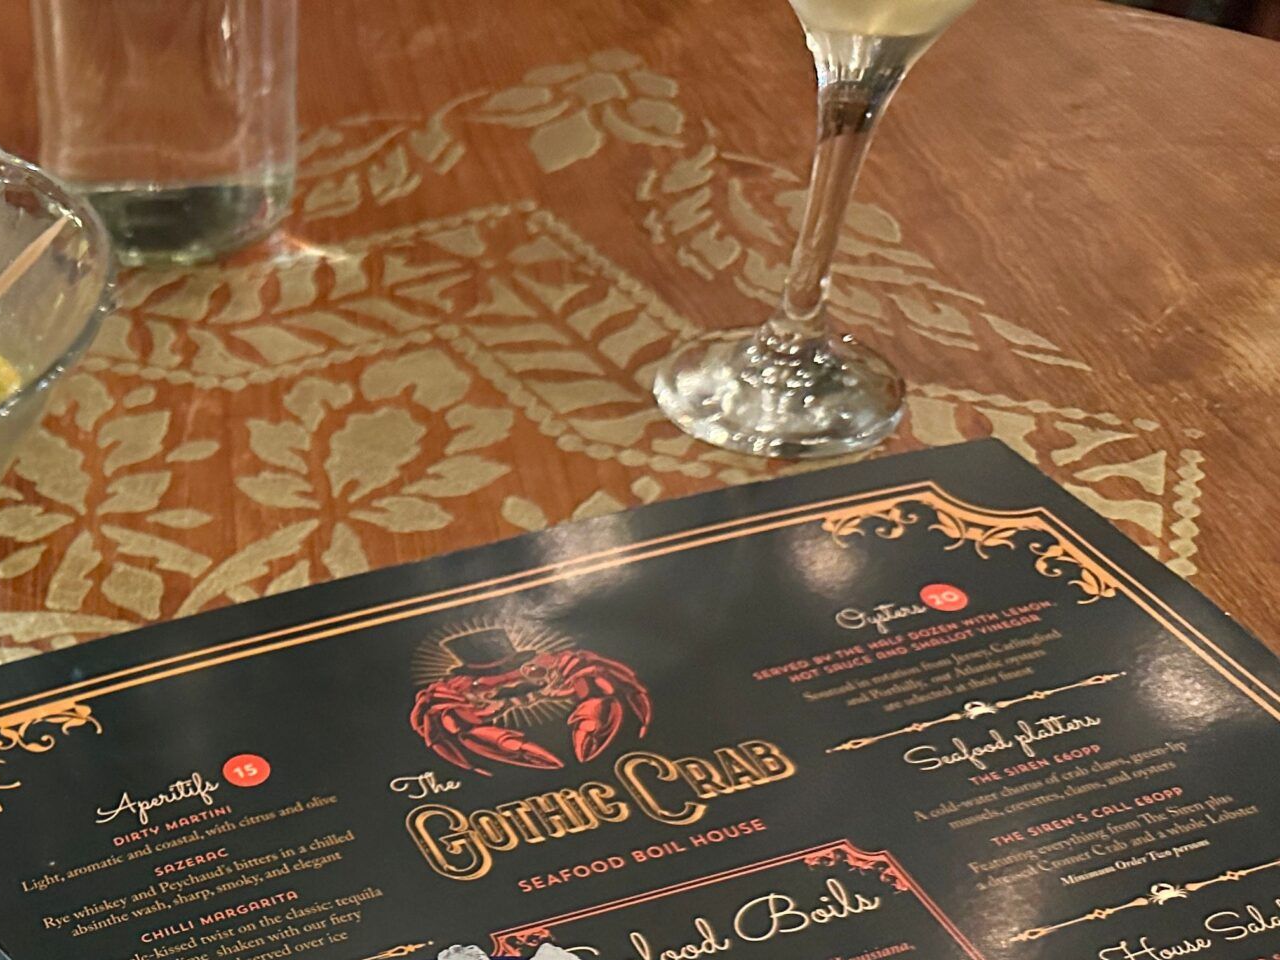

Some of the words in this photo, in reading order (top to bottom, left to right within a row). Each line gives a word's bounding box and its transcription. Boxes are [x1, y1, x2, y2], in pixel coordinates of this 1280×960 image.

[836, 601, 927, 634] Oysters
[752, 659, 813, 680] SERVED
[811, 653, 837, 668] BY
[834, 644, 868, 663] THE
[867, 635, 905, 655] HALF
[907, 622, 963, 646] DOZEN
[961, 612, 1004, 633] WITH
[788, 667, 819, 683] HOT
[822, 654, 872, 673] SAUCE
[875, 645, 908, 659] AND
[910, 628, 973, 651] SHALLOT
[978, 613, 1041, 633] VINEGAR
[904, 733, 1013, 771] Seafood
[1014, 713, 1101, 757] platters
[390, 772, 461, 799] The
[614, 741, 796, 826] CRAB
[969, 770, 1002, 785] THE
[1003, 758, 1050, 776] SIREN
[1106, 770, 1132, 785] and
[95, 772, 219, 825] Aperitifs
[991, 830, 1024, 846] THE
[1090, 801, 1132, 818] CALL
[21, 874, 65, 892] Light,
[66, 855, 123, 878] aromatic
[126, 843, 152, 860] and
[154, 829, 204, 851] coastal,
[204, 820, 236, 836] with
[238, 811, 276, 827] citrus
[278, 800, 304, 816] and
[305, 795, 337, 809] olive
[112, 825, 159, 846] DIRTY
[164, 805, 231, 830] MARTINI
[1037, 829, 1109, 854] everything
[1106, 819, 1146, 841] from
[1140, 811, 1168, 824] The
[1165, 802, 1210, 825] Siren
[1130, 829, 1156, 846] and
[42, 914, 70, 929] Rye
[73, 897, 126, 918] whiskey
[130, 885, 157, 902] and
[158, 864, 232, 895] Peychaud's
[233, 853, 278, 877] bitters
[279, 848, 295, 866] in
[298, 845, 307, 854] a
[309, 829, 355, 850] chilled
[154, 847, 227, 876] SAZERAC
[518, 856, 625, 892] SEAFOOD
[631, 841, 684, 862] BOIL
[689, 818, 766, 846] HOUSE
[72, 906, 128, 936] absinthe
[131, 899, 171, 917] wash,
[172, 888, 215, 905] sharp,
[215, 874, 263, 893] smoky,
[264, 862, 290, 879] and
[292, 851, 342, 870] elegant
[140, 920, 194, 943] CHILLI
[199, 890, 298, 925] MARGARITA
[199, 928, 234, 946] twist
[237, 922, 257, 933] on
[258, 914, 282, 931] the
[334, 887, 383, 906] tequila
[733, 877, 881, 942] Boils
[1205, 899, 1280, 940] Sala
[216, 937, 265, 959] shaken
[267, 925, 300, 946] with
[302, 919, 329, 935] our
[329, 910, 361, 925] fiery
[294, 937, 324, 952] over
[326, 931, 348, 943] ice
